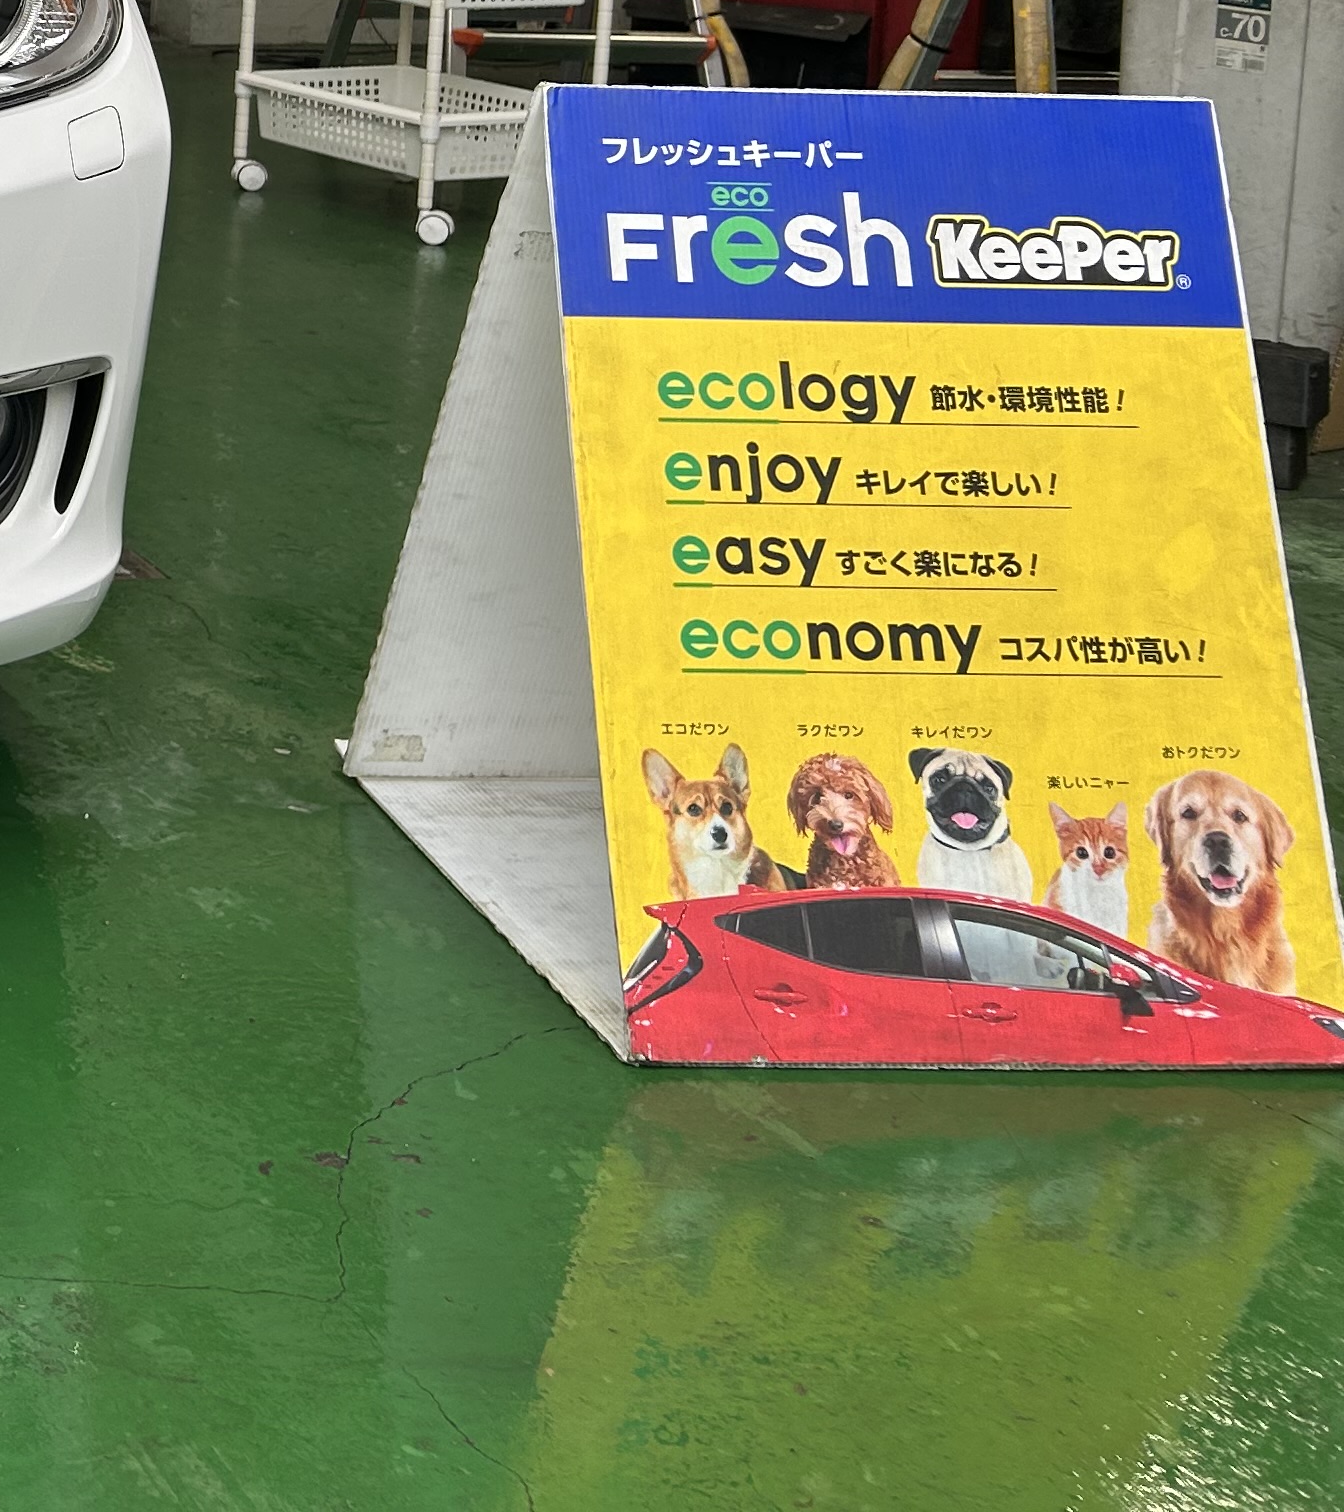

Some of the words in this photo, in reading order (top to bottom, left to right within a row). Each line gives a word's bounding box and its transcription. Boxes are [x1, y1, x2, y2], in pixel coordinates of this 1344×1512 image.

[601, 137, 864, 169] フレッシュキーパー
[711, 186, 769, 208] eco
[606, 191, 914, 287] Fresh
[930, 218, 1176, 288] KeePer
[658, 360, 917, 423] ecology
[929, 384, 1125, 414] 節水・環境性能!
[665, 441, 843, 505] enjoy
[855, 469, 1057, 498] キレイで楽しい!
[672, 535, 827, 587] easy
[835, 549, 1038, 578] すごく楽になる!
[680, 618, 982, 675] economy
[999, 635, 1206, 665] コスパ性が高い!
[661, 722, 730, 736] エコだワン
[796, 724, 864, 738] ラクだワン
[911, 726, 993, 739] キレイだワン
[1161, 746, 1241, 760] おトクだワン
[1046, 776, 1129, 790] 楽しいニャー
